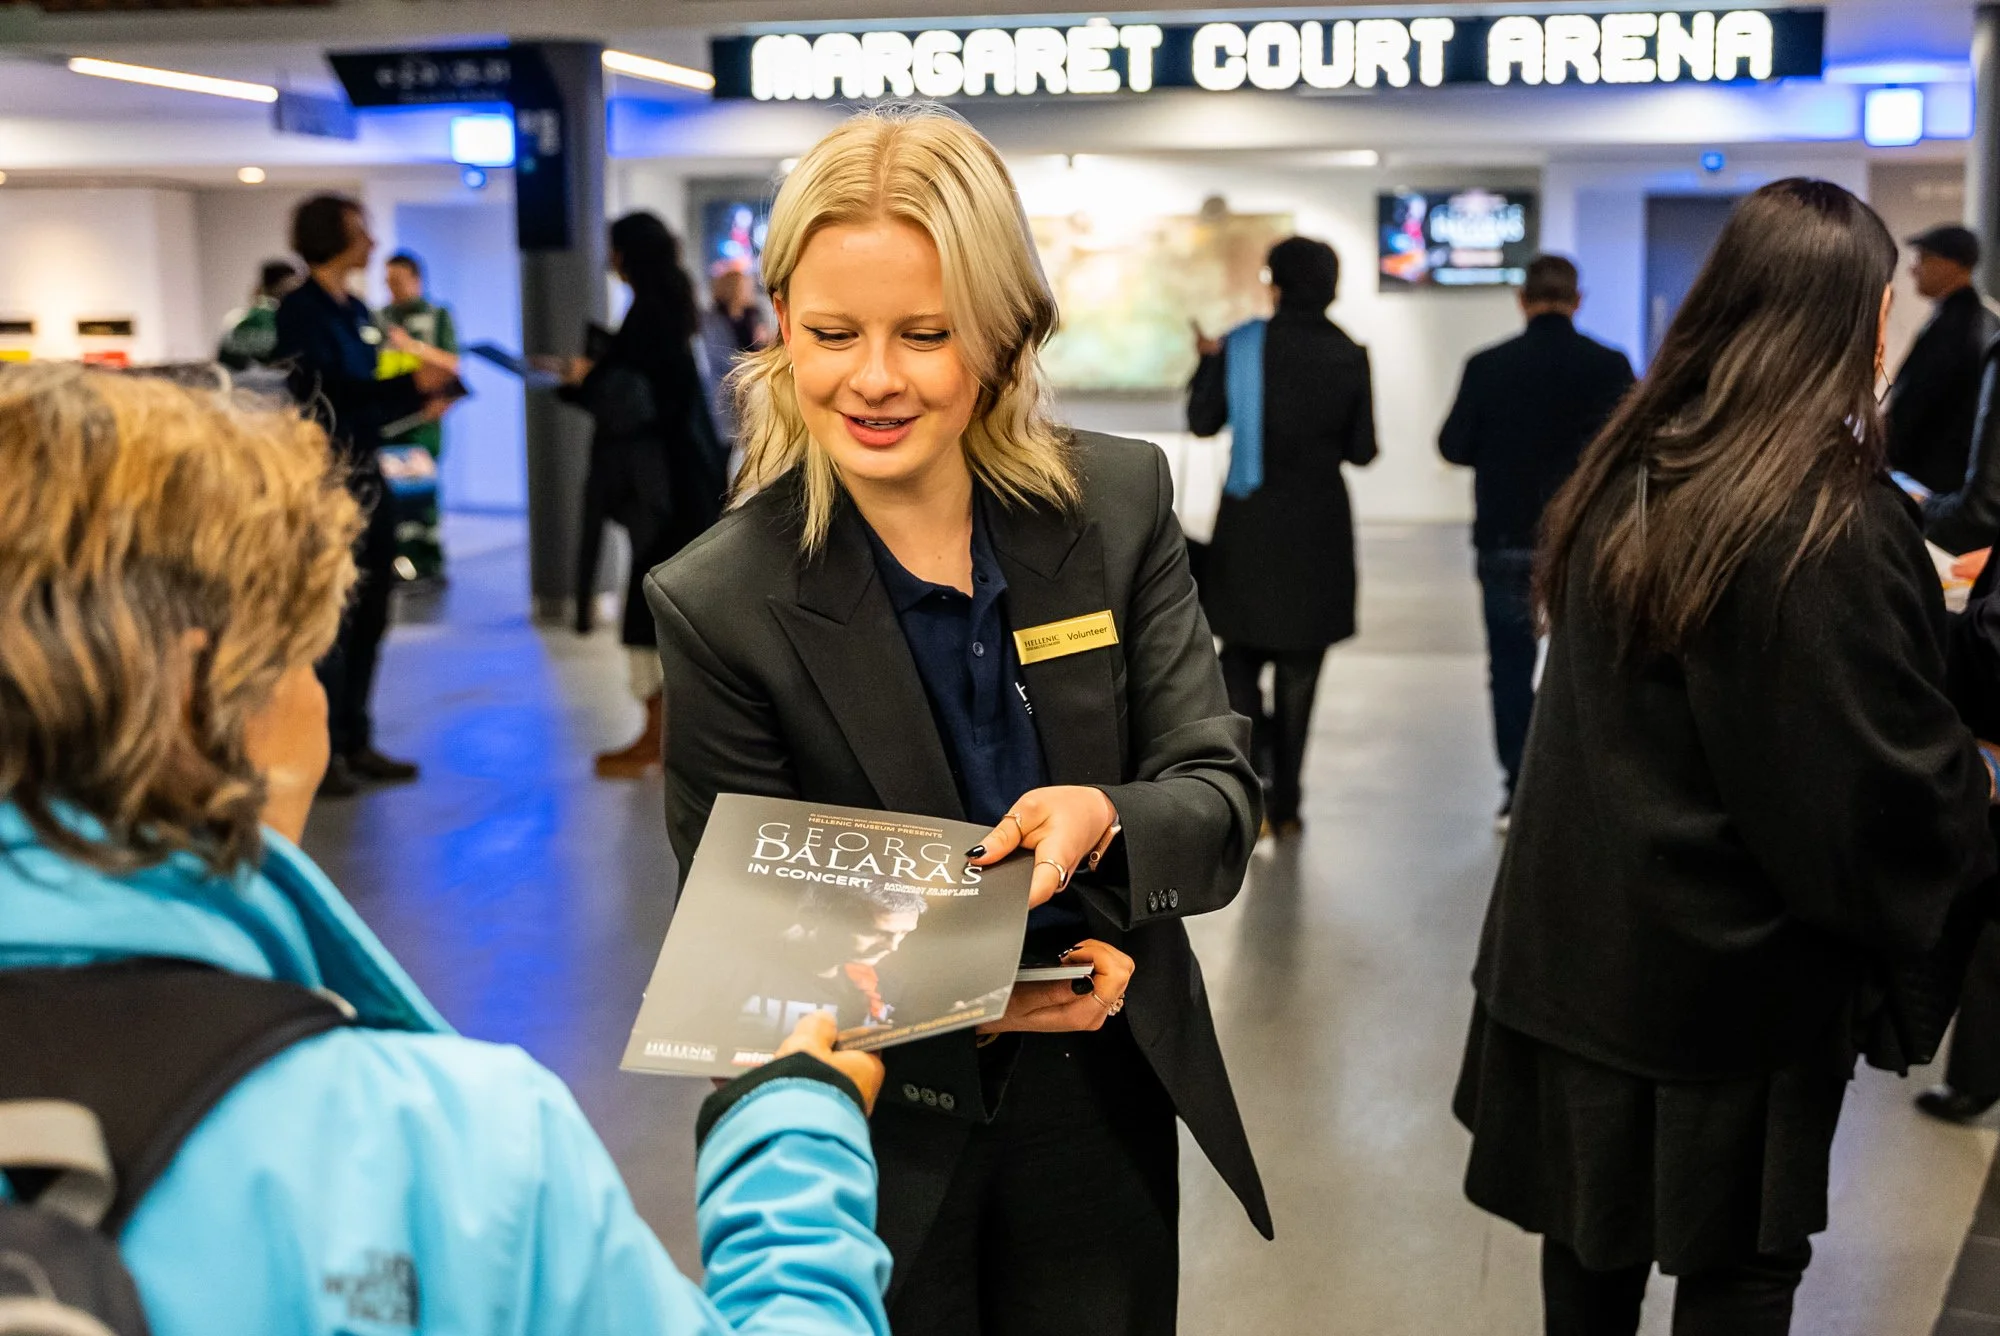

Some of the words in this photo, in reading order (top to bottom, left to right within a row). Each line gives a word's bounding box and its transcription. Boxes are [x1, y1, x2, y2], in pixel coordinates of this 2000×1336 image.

[751, 24, 1163, 100] MARGARET
[1193, 17, 1455, 91] COURT
[1487, 10, 1773, 85] ARENA
[1024, 634, 1060, 648] HELLENIC
[1067, 626, 1108, 641] Volunteer
[808, 816, 852, 827] HELLENIC
[854, 822, 895, 832] MUSEUM
[898, 827, 943, 839] PRESENTS
[758, 822, 953, 864] GEORG
[752, 838, 983, 884] DALARAS
[747, 863, 770, 875] IN
[775, 866, 873, 888] CONCERT
